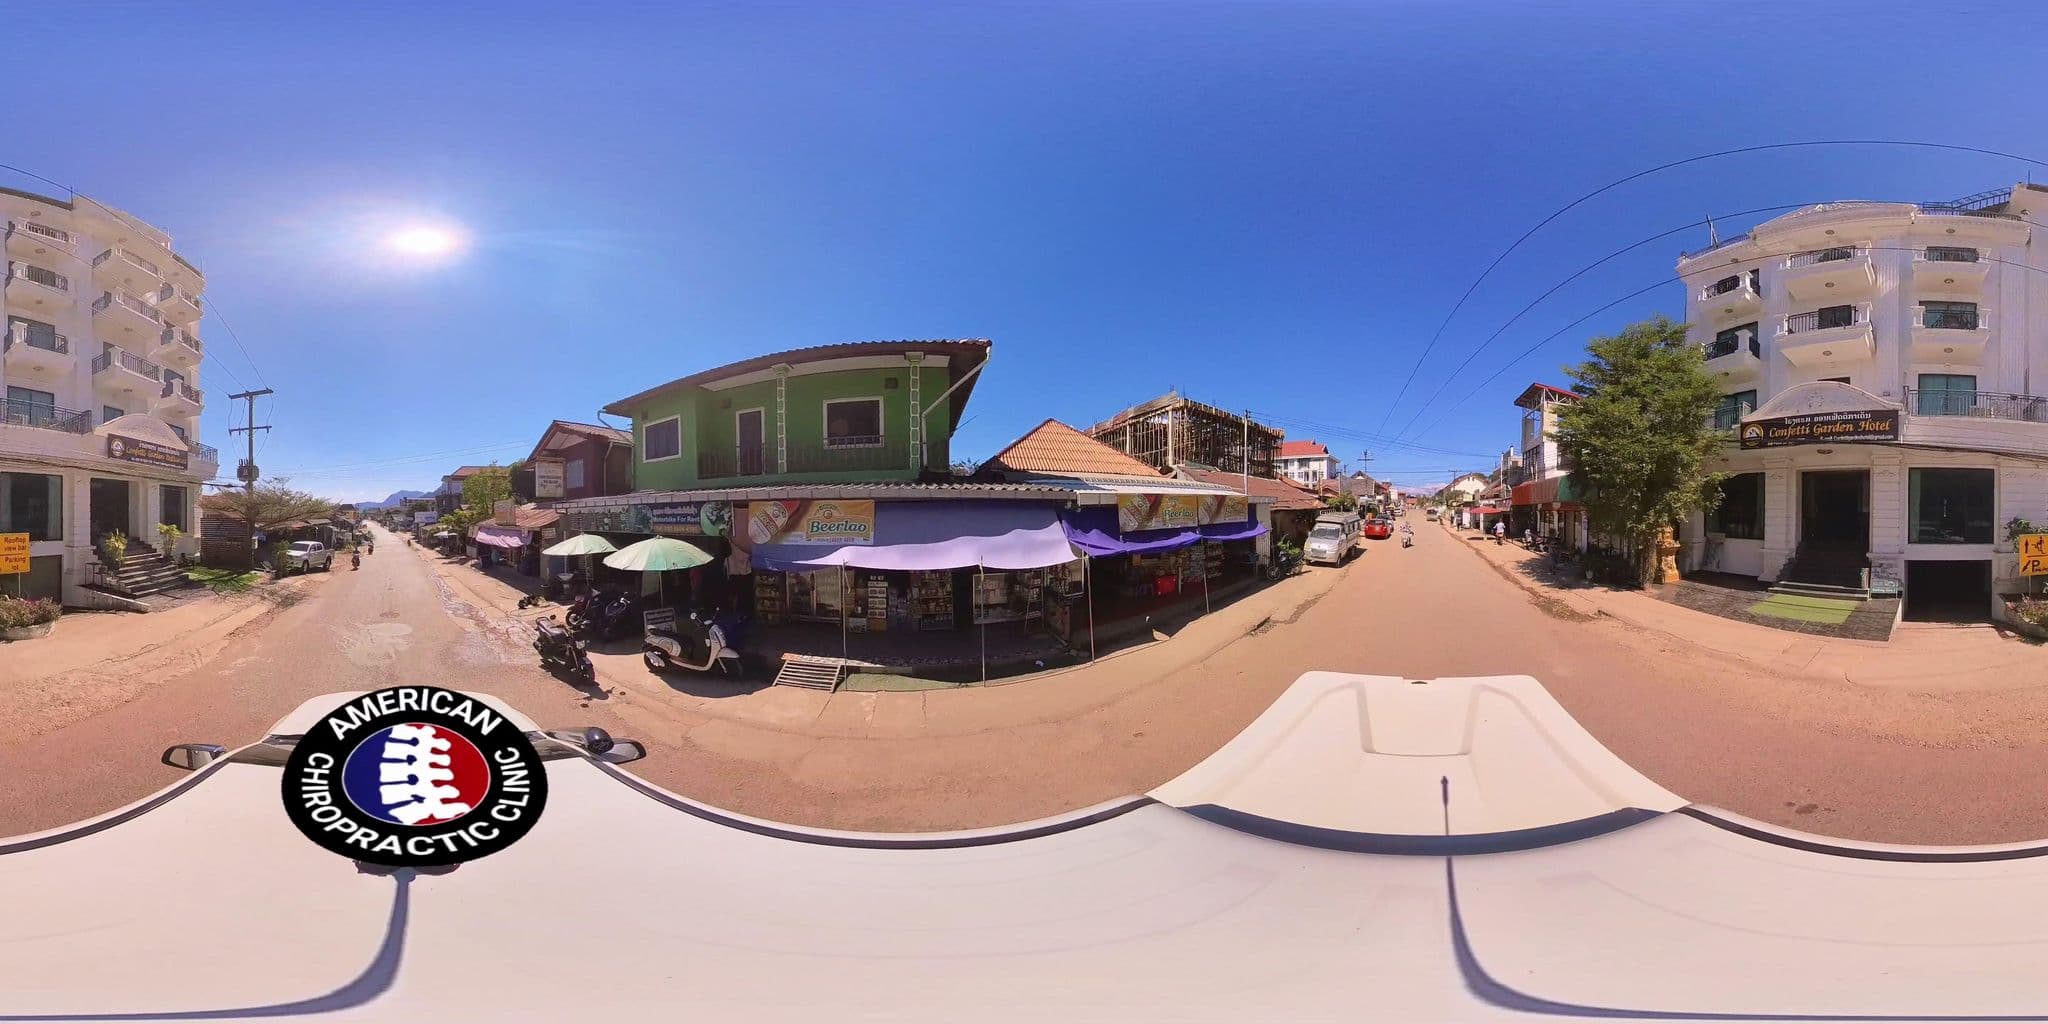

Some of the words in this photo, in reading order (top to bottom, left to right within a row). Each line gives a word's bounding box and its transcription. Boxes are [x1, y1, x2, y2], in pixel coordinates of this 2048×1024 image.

[1769, 423, 1811, 440] Confetti
[1813, 421, 1855, 436] Garden
[1857, 418, 1893, 432] Hotel
[810, 520, 867, 533] Beerlao
